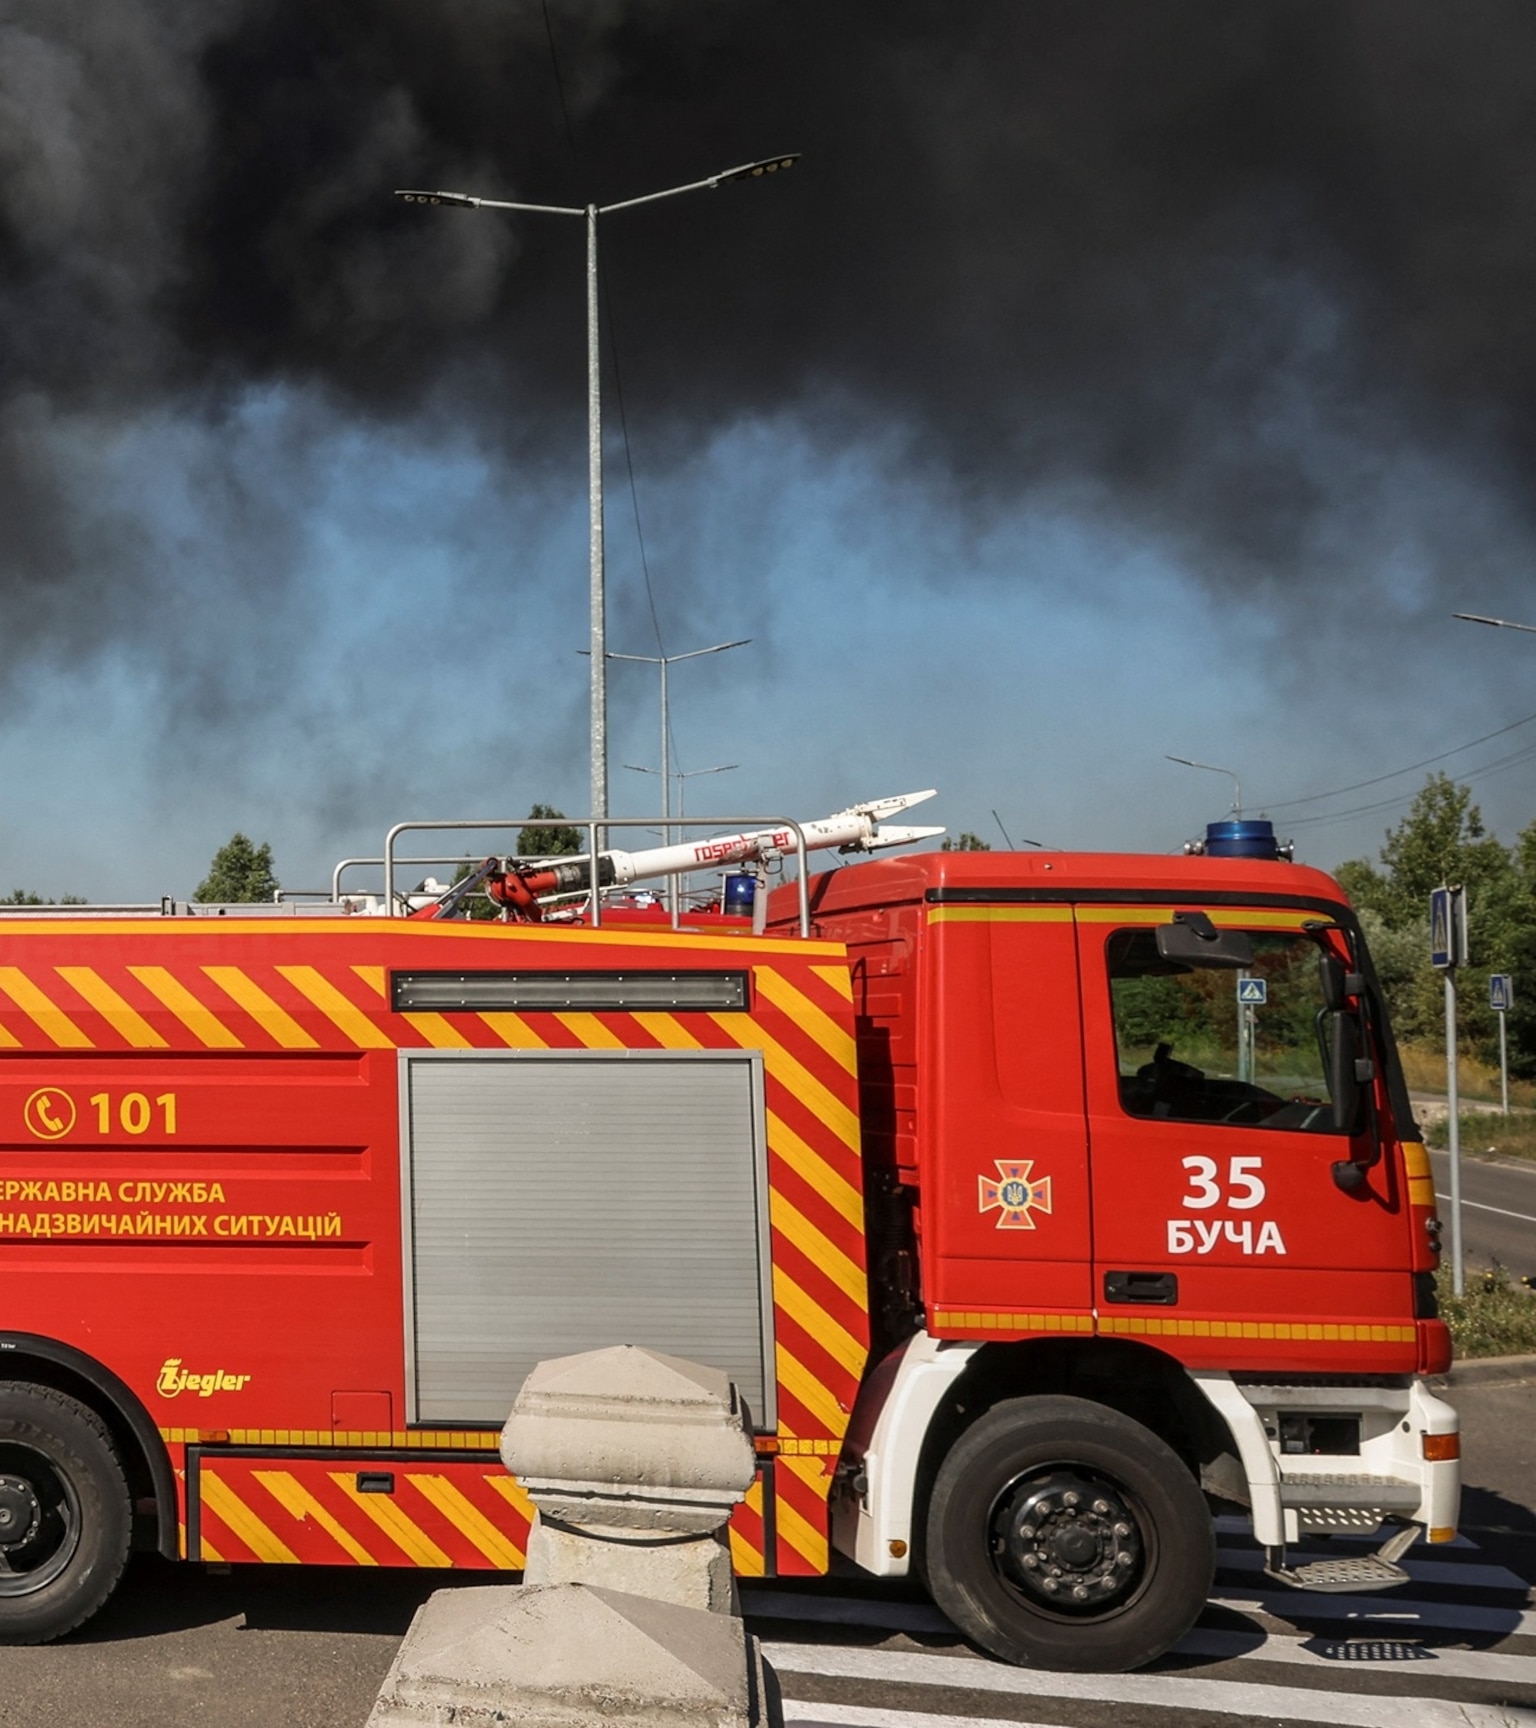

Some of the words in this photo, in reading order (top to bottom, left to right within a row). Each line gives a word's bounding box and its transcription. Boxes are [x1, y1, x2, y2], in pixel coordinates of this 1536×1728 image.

[90, 1092, 177, 1135] 101
[119, 1181, 225, 1203] СЛУЖБА
[1181, 1155, 1267, 1210] 35
[213, 1213, 342, 1239] СИТУАЦІЙ
[1166, 1220, 1287, 1256] БУЧА
[156, 1358, 251, 1398] Ziegler
